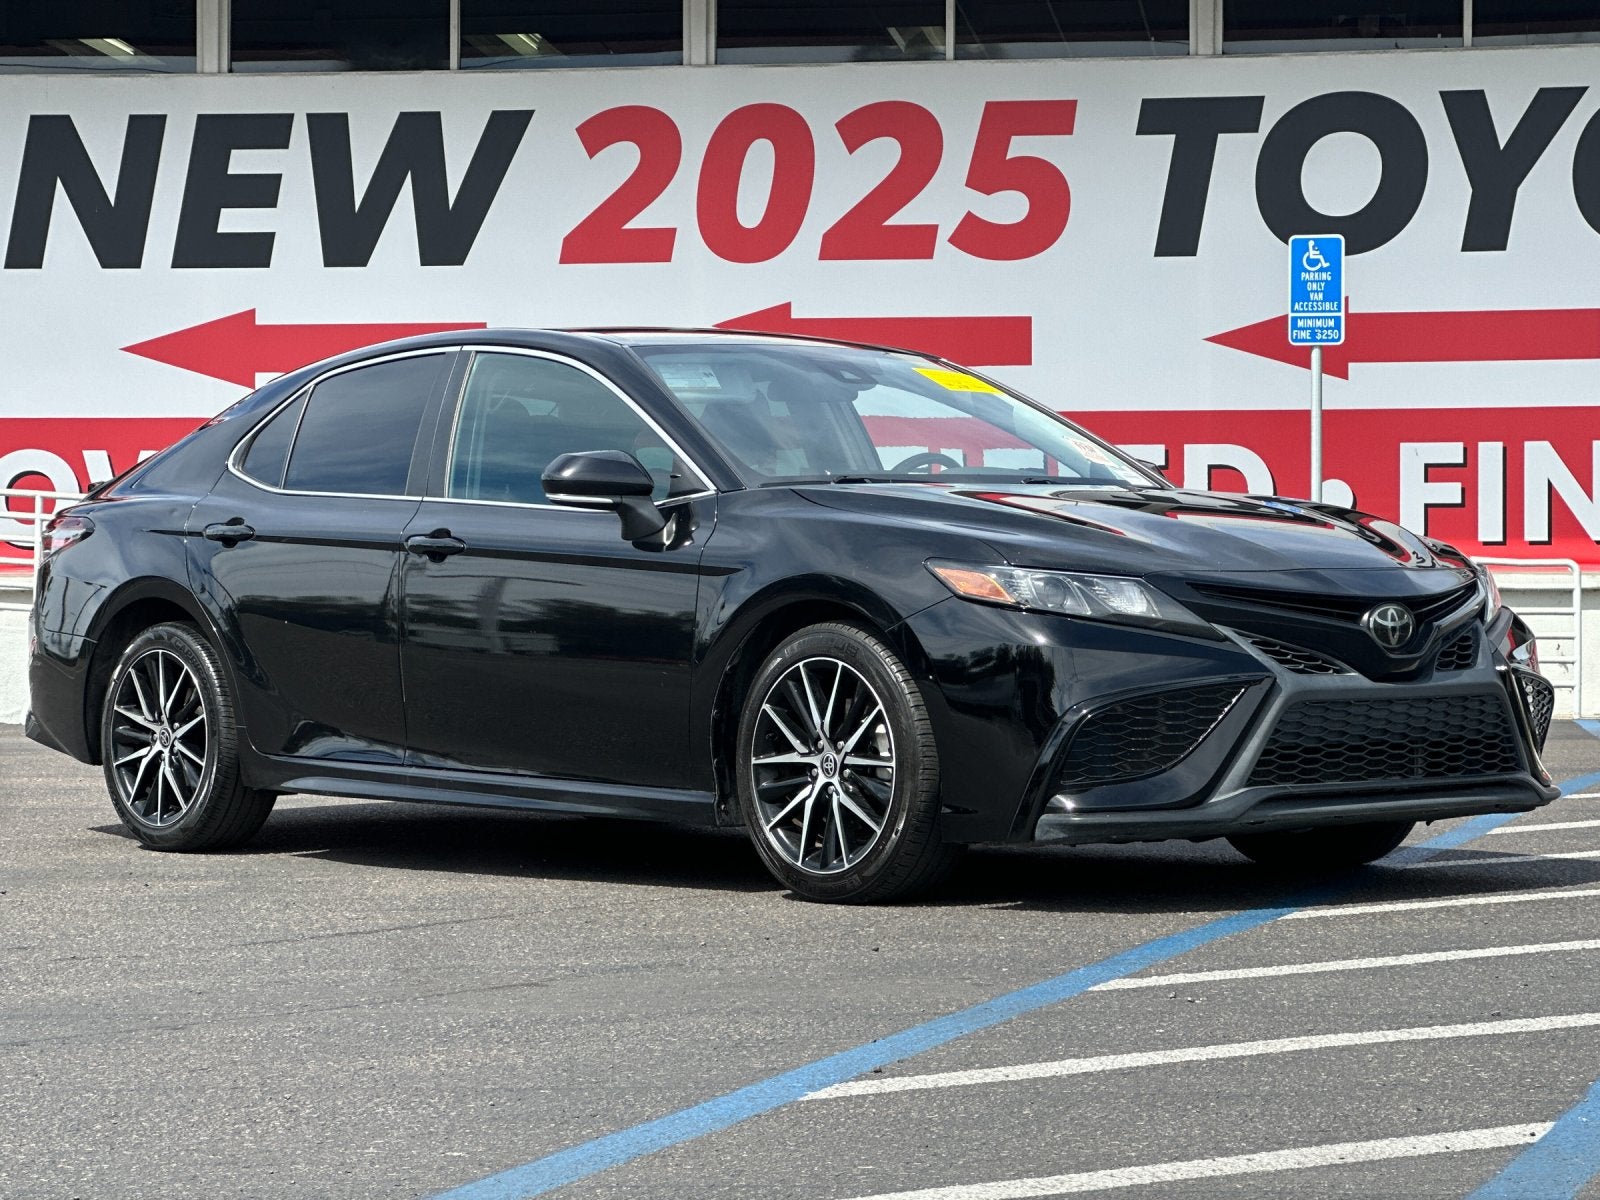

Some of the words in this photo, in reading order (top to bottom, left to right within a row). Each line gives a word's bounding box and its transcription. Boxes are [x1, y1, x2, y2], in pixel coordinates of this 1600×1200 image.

[5, 109, 534, 270] NEW
[560, 100, 1076, 265] 2025
[1136, 86, 1600, 257] TOY
[1300, 271, 1331, 281] PARKING
[1306, 281, 1325, 291] ONLY
[1309, 291, 1323, 301] VAN
[1294, 301, 1338, 311] ACCESSIBLE
[1297, 318, 1334, 328] MINIMUM
[1292, 329, 1311, 340] FINE
[1315, 329, 1339, 340] $250
